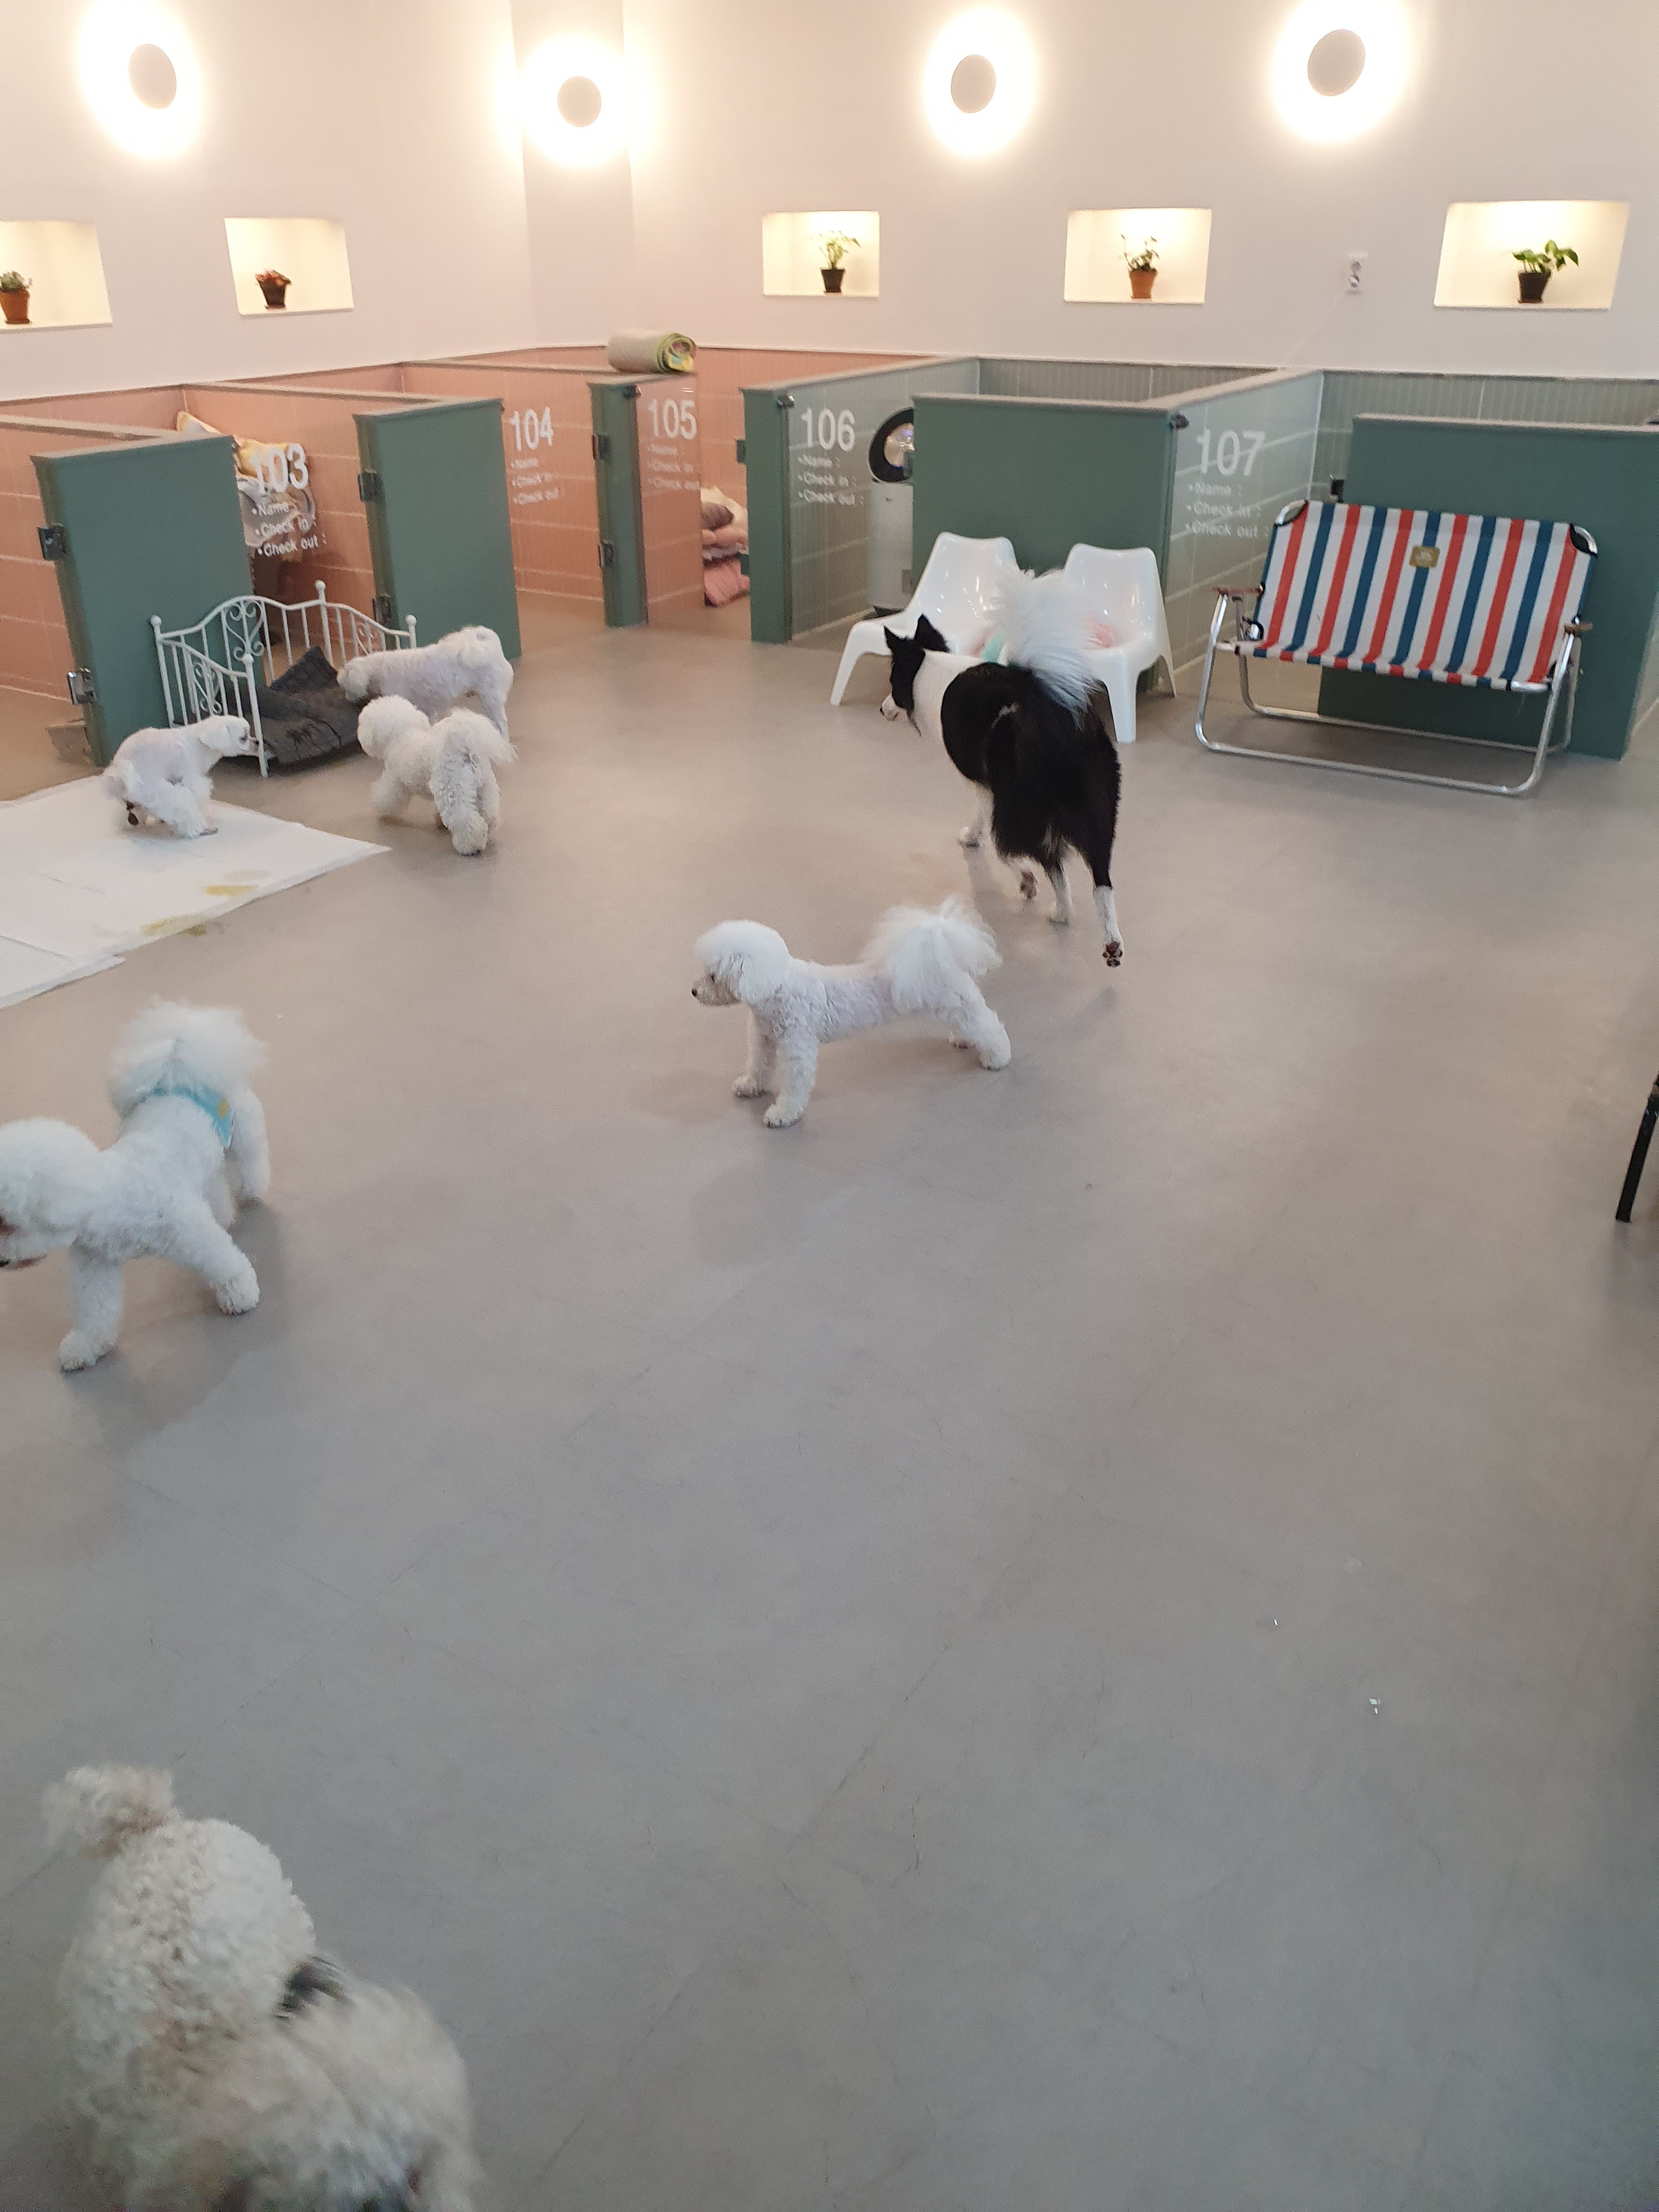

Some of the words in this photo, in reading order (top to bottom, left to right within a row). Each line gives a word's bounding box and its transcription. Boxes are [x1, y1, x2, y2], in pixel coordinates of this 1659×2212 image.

[510, 406, 554, 451] 104
[647, 398, 697, 441] 105
[801, 407, 855, 452] 106
[250, 443, 308, 494] 103
[1197, 427, 1265, 476] 107
